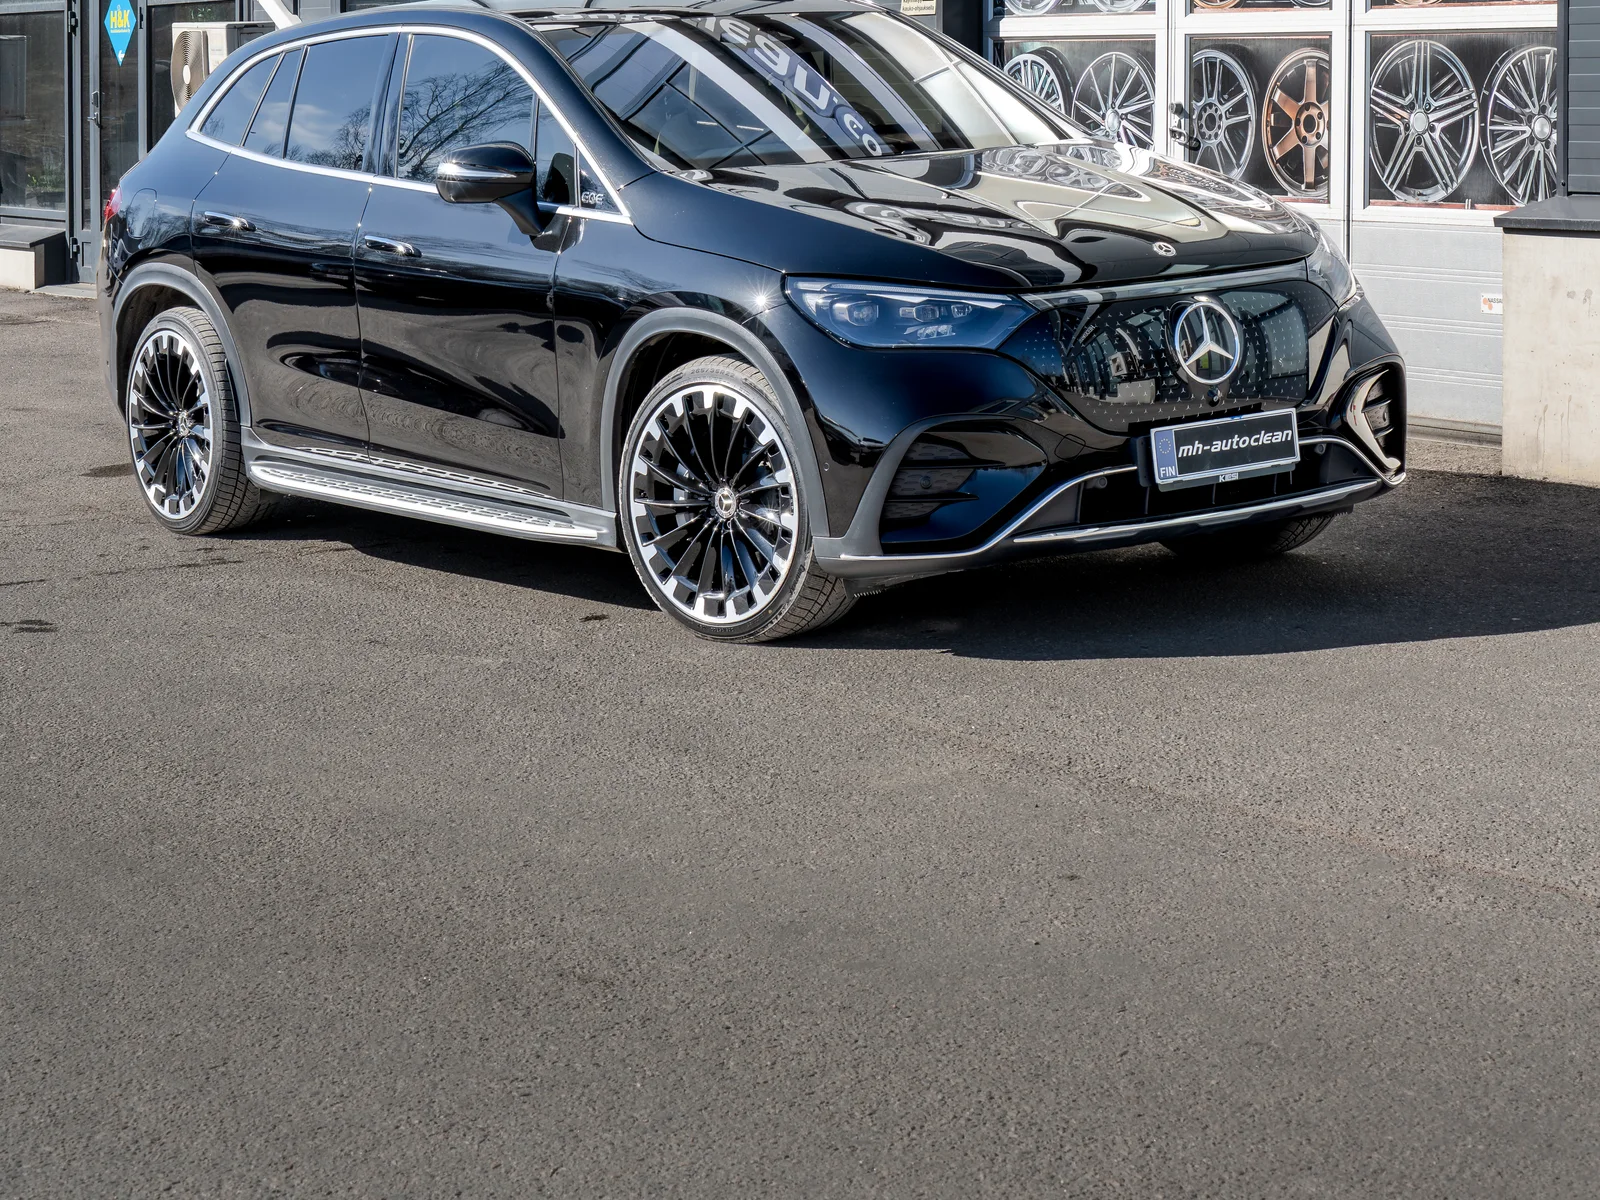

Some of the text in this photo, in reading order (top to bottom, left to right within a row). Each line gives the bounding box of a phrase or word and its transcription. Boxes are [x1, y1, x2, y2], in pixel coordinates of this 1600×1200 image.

[110, 9, 130, 28] H&K
[581, 191, 604, 205] EQE
[1177, 429, 1293, 458] mh-autoclean
[1160, 465, 1176, 478] FIN
